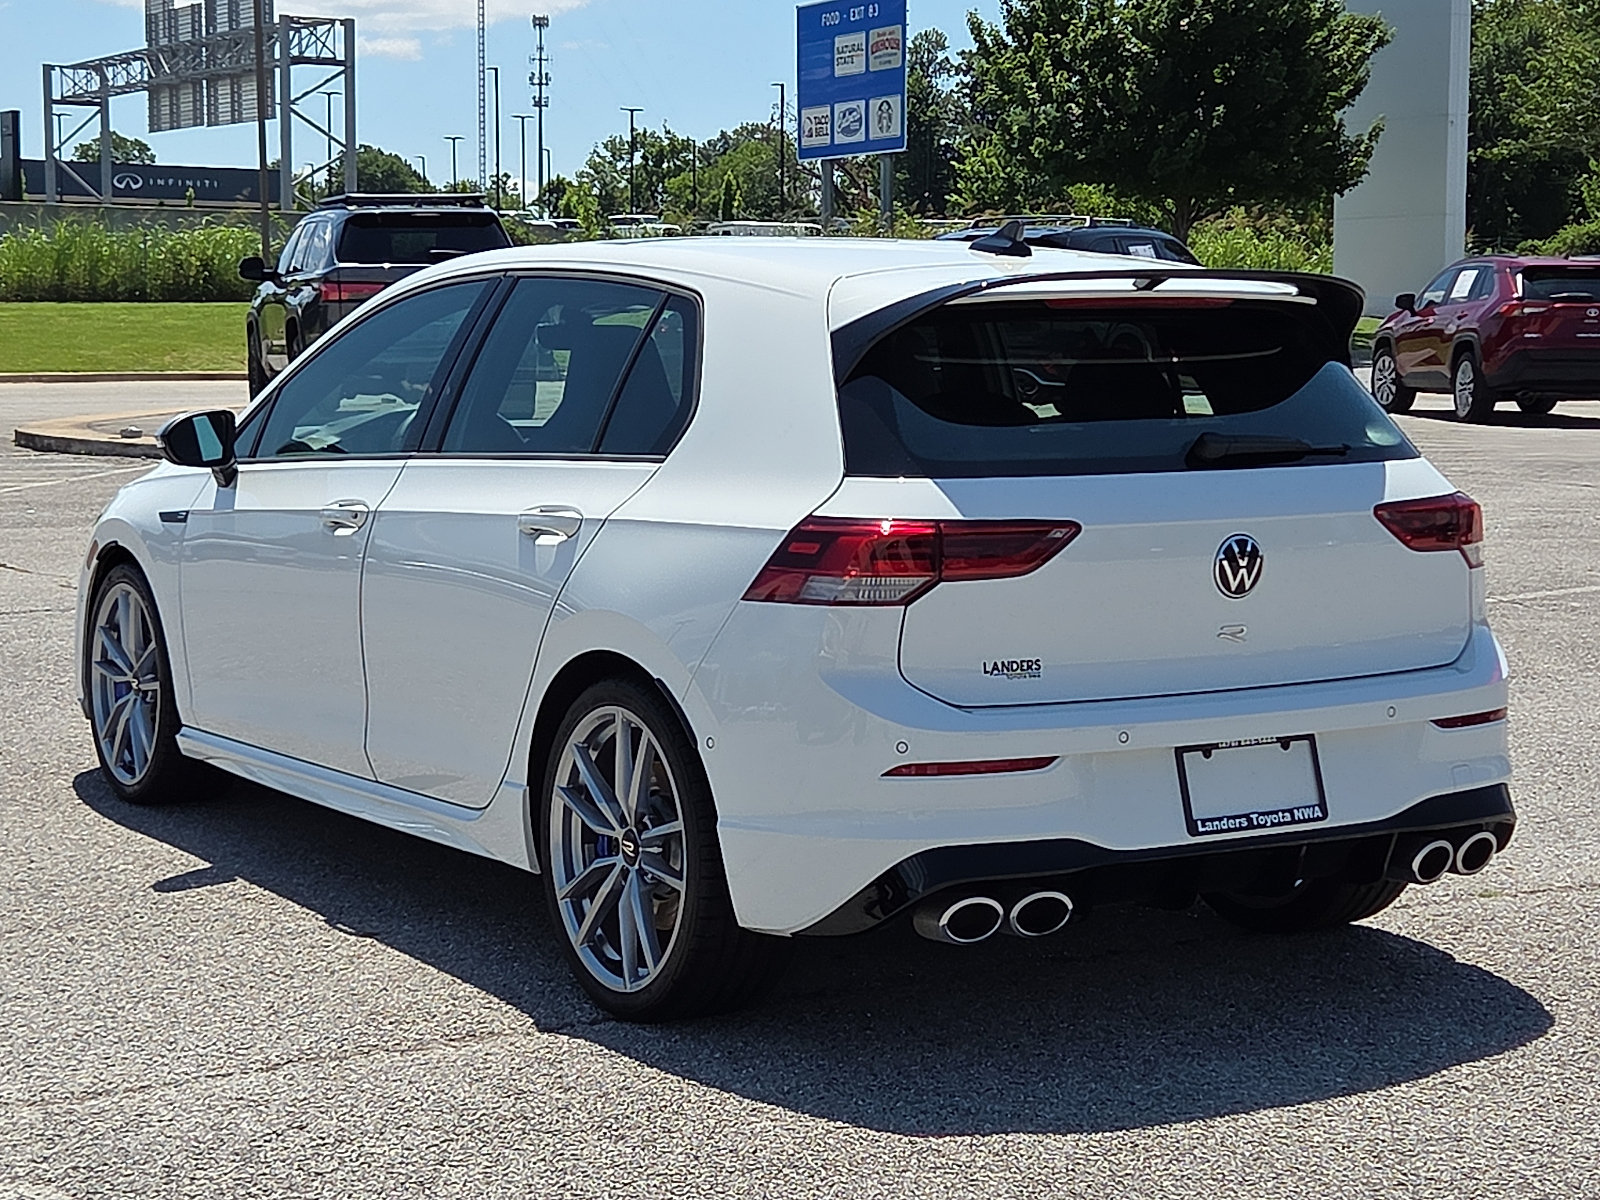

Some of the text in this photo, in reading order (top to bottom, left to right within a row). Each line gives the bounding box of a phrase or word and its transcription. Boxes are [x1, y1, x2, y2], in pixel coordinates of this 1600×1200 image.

[821, 11, 840, 27] FOOD
[850, 6, 865, 21] EXIT
[836, 42, 864, 55] NATURAL
[836, 55, 855, 67] STATE
[813, 114, 829, 126] TACO
[814, 125, 829, 137] BELL
[149, 178, 218, 188] INFINITI
[983, 658, 1041, 676] LANDERS
[1197, 805, 1323, 832] Landers Toyota NWA
